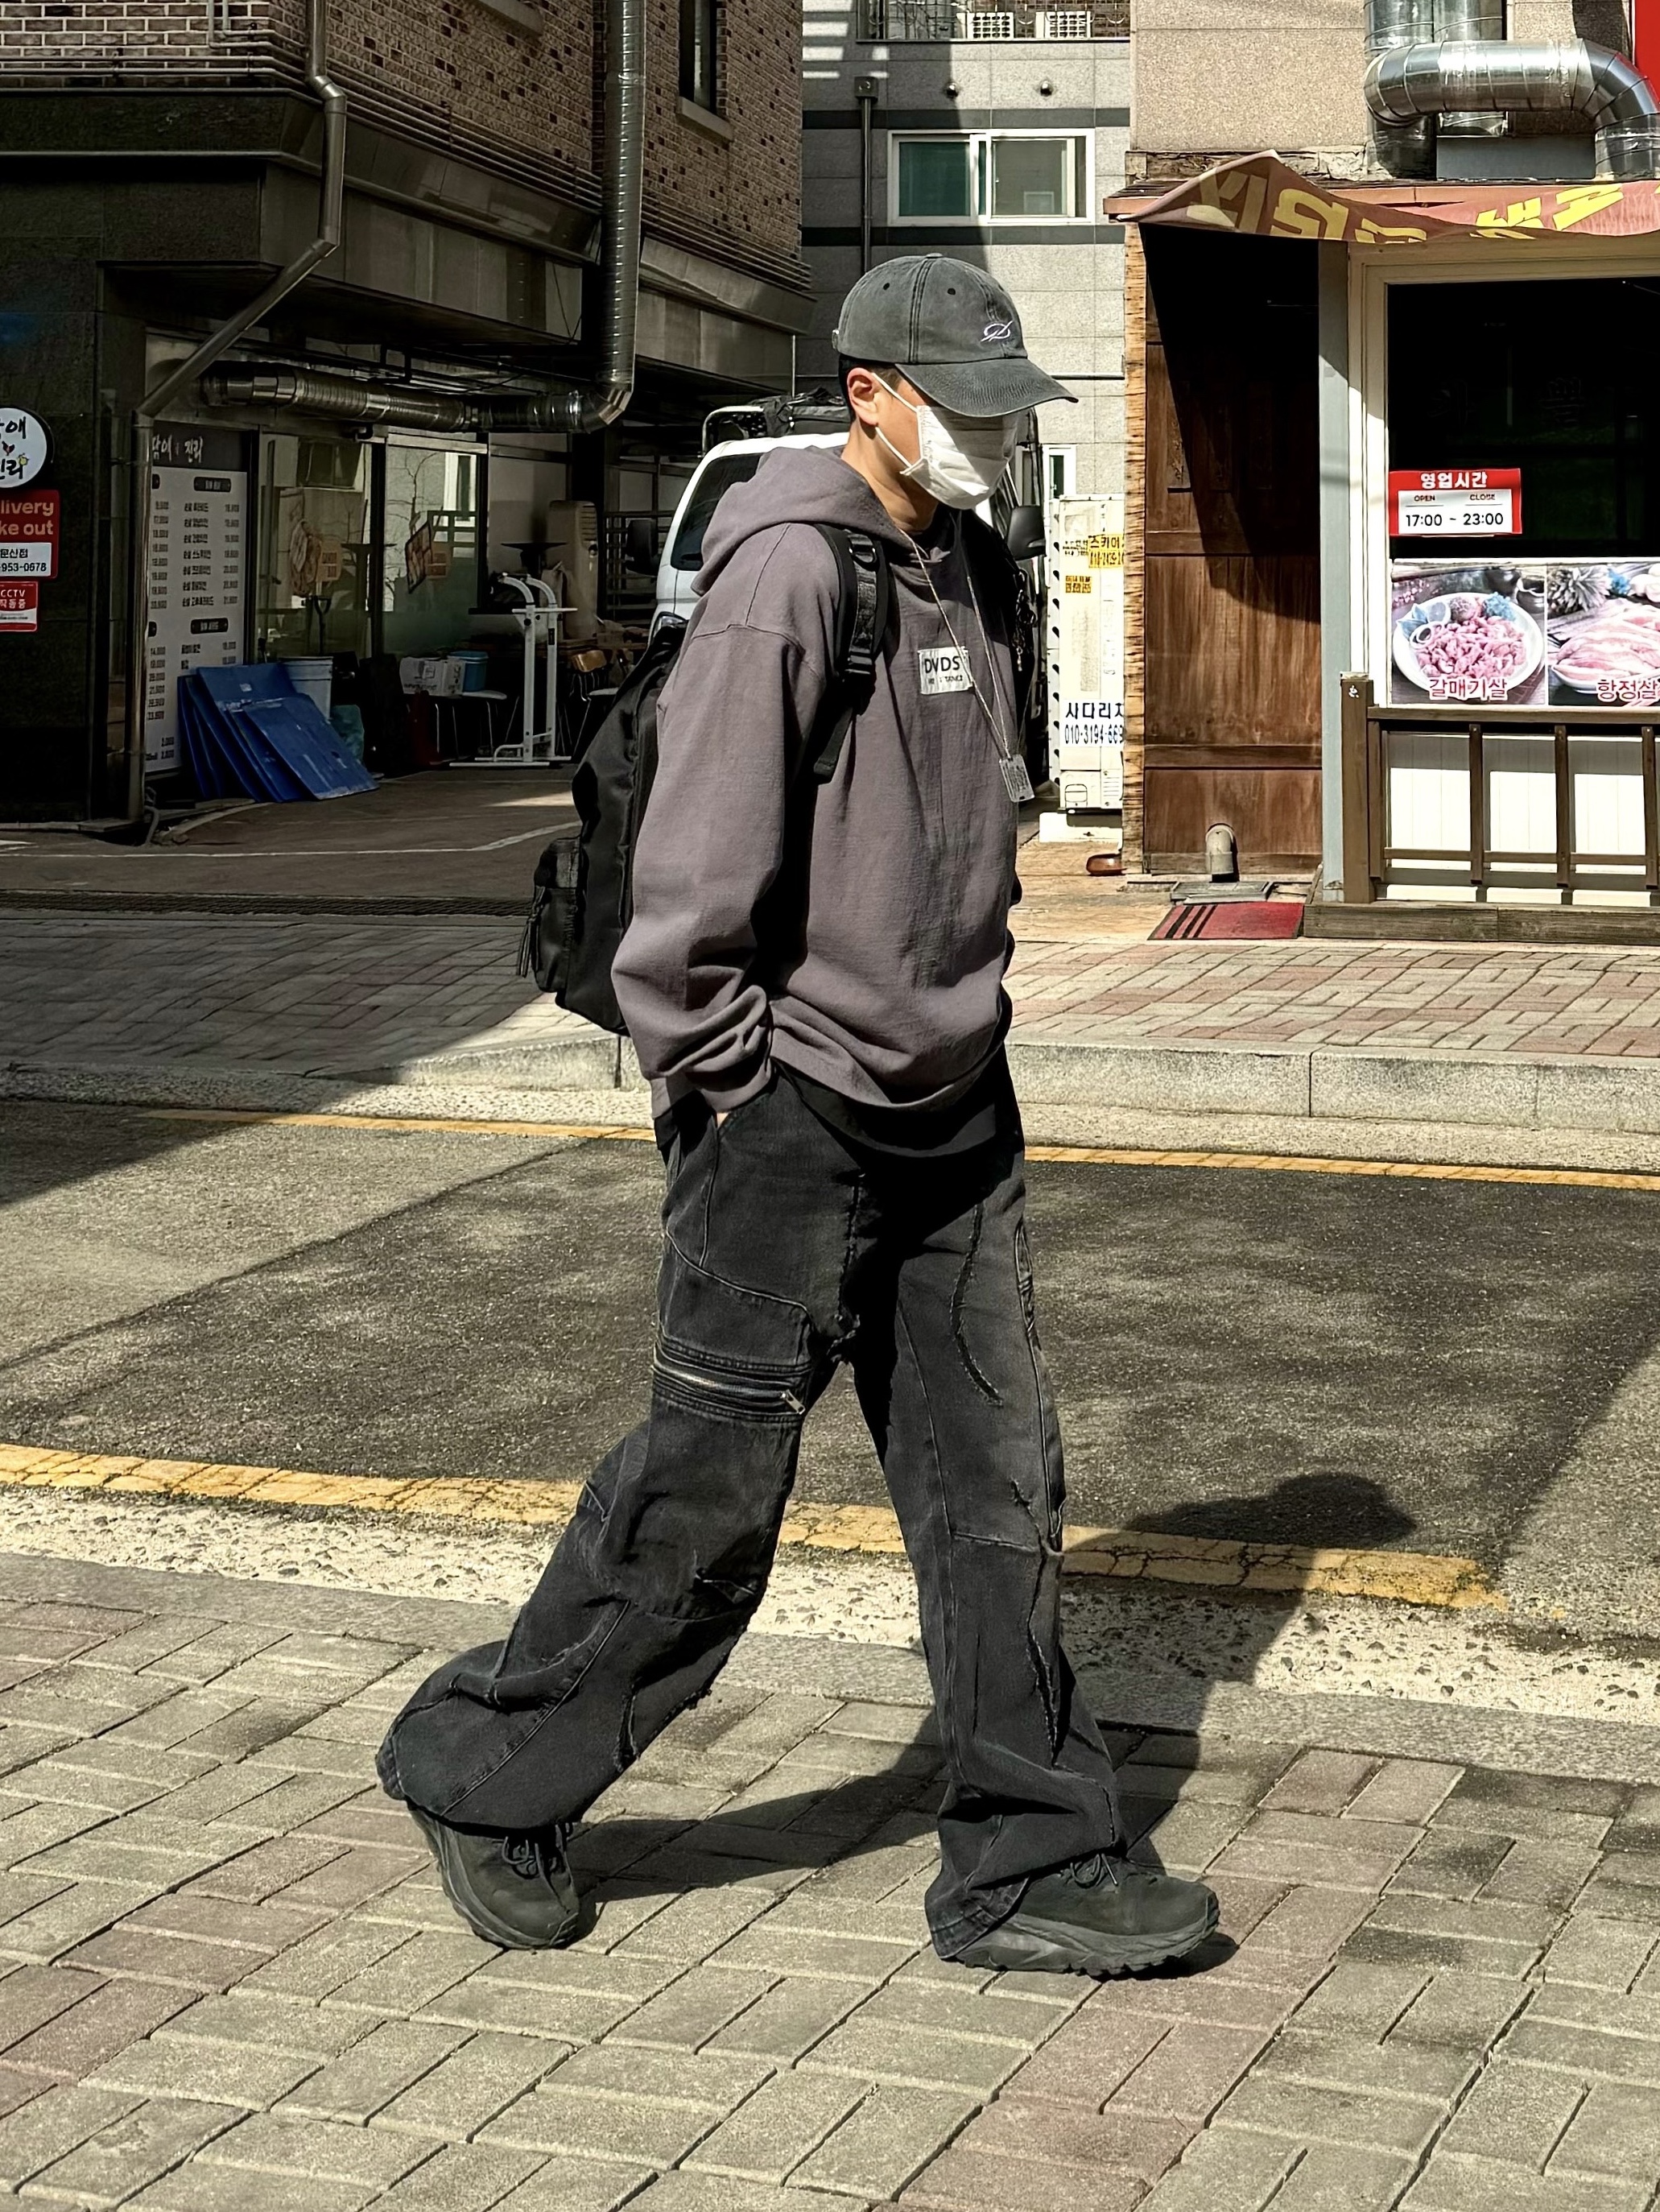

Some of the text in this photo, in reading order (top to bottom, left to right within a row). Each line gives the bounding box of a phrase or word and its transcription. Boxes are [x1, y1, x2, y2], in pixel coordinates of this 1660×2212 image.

[1420, 471, 1489, 490] 영업시간
[1414, 493, 1496, 502] OPEN CLOSE
[1406, 514, 1443, 527] 17:00
[1463, 512, 1504, 526] 23:00
[23, 520, 54, 535] out
[0, 562, 47, 572] 953-0678
[1, 589, 26, 597] CCTV
[923, 655, 960, 674] DVDS
[1429, 678, 1508, 699] 갈매기살
[1597, 679, 1658, 700] 항정살
